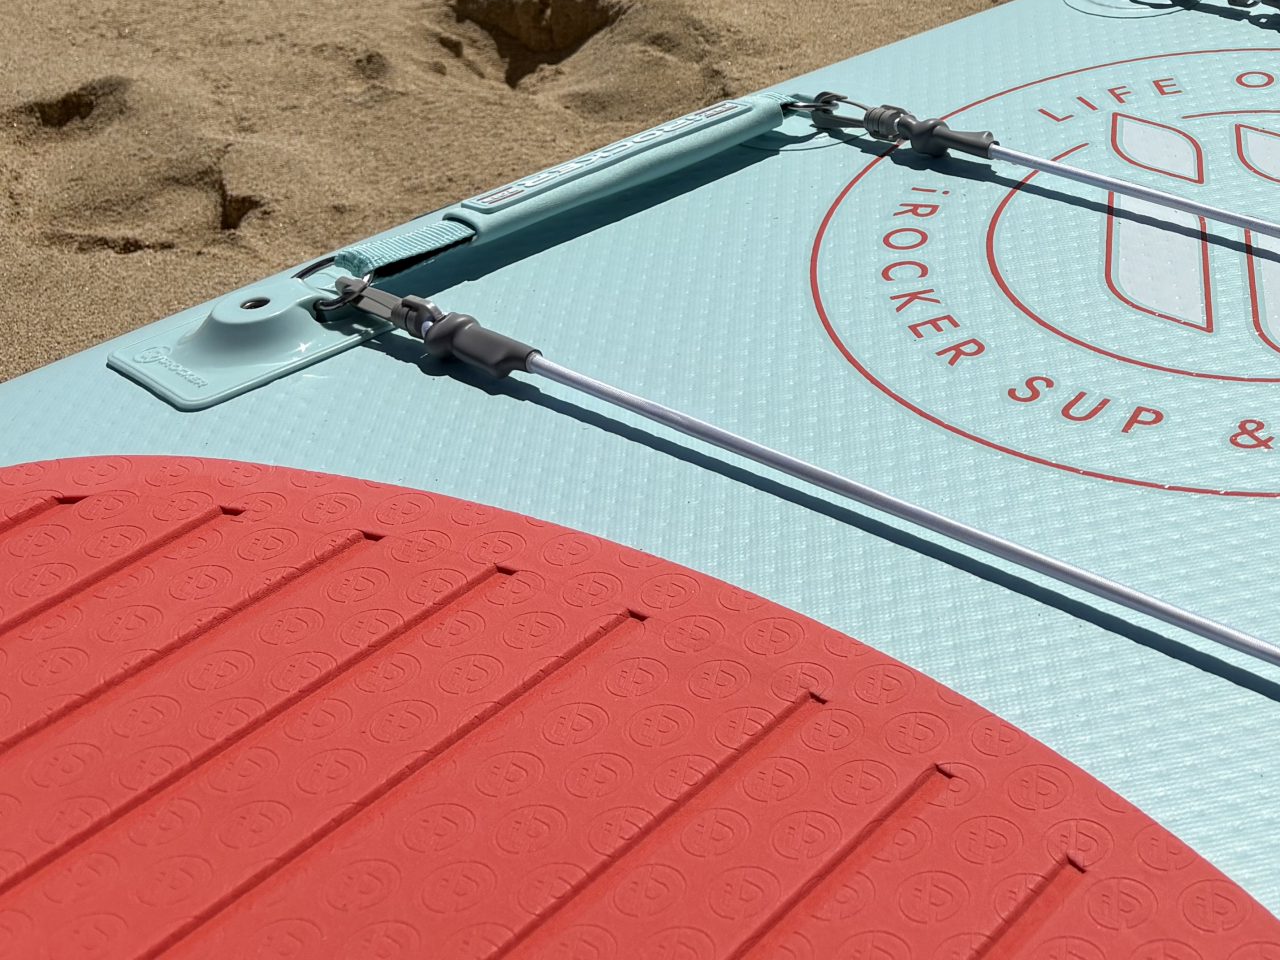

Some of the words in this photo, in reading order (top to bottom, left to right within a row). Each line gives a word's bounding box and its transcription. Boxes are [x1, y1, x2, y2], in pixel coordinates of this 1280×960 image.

[1039, 78, 1181, 123] LIFE
[881, 187, 986, 367] iROCKER
[1007, 376, 1164, 433] SUP
[1229, 419, 1274, 449] &
